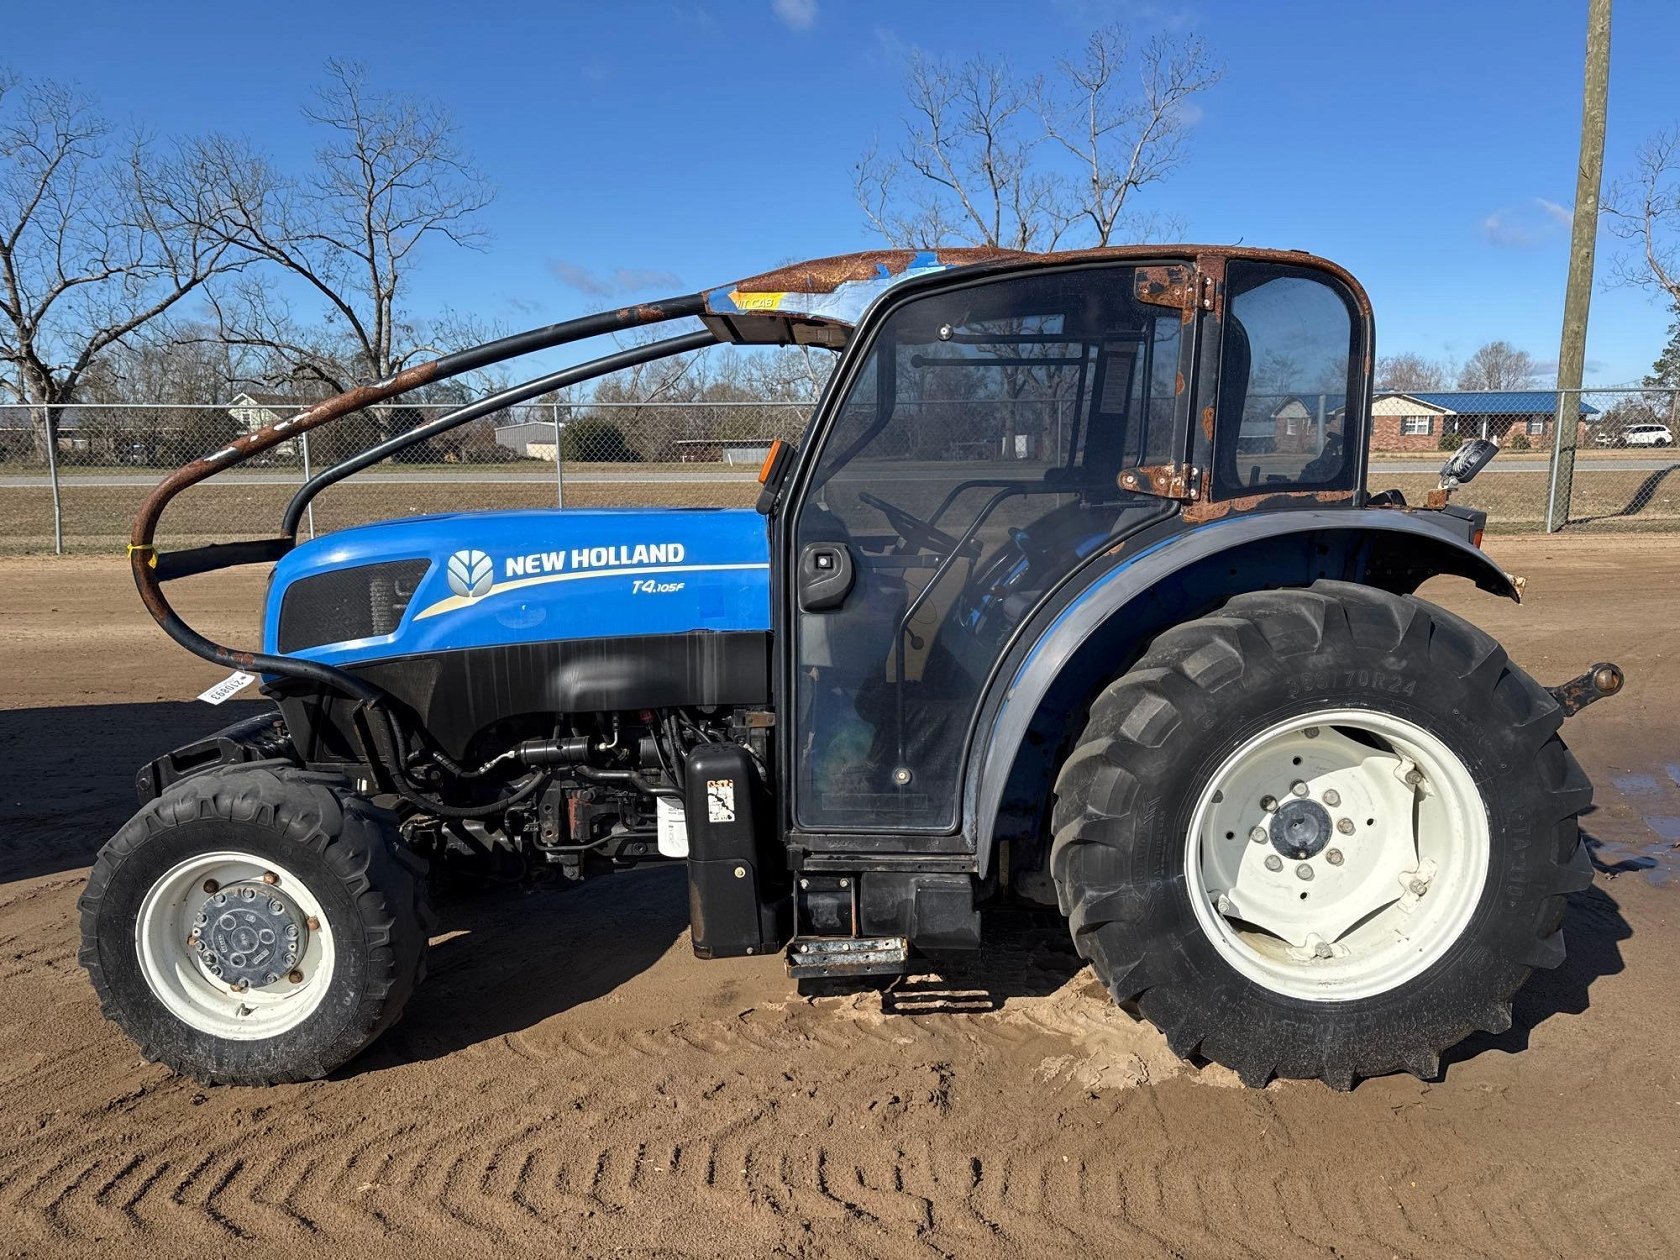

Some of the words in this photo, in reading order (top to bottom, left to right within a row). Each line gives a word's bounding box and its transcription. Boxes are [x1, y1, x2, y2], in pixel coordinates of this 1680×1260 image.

[752, 299, 775, 309] CAB
[505, 550, 566, 577] NEW
[571, 543, 686, 568] HOLLAND
